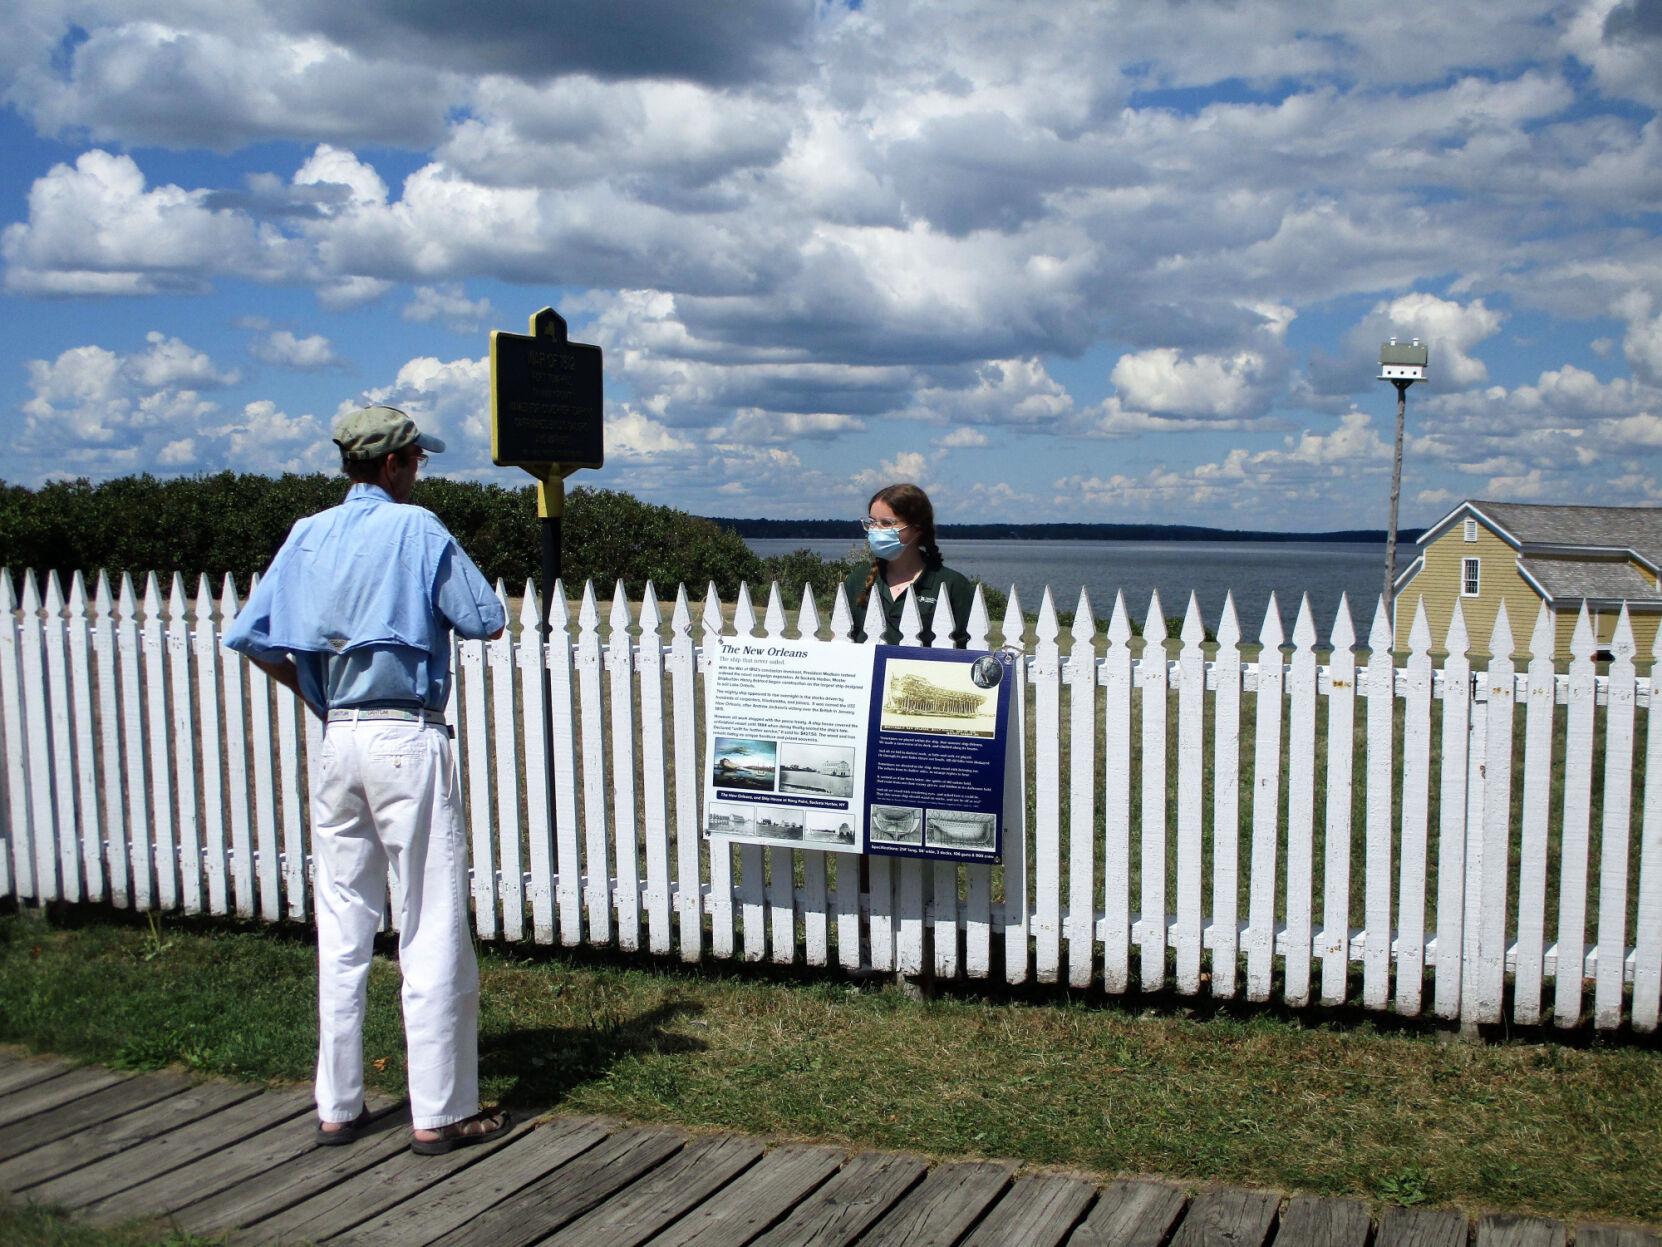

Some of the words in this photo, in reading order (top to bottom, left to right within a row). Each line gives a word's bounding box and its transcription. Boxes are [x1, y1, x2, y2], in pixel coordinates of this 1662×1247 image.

[722, 644, 740, 654] The
[743, 646, 764, 656] New
[768, 648, 808, 658] Orleans
